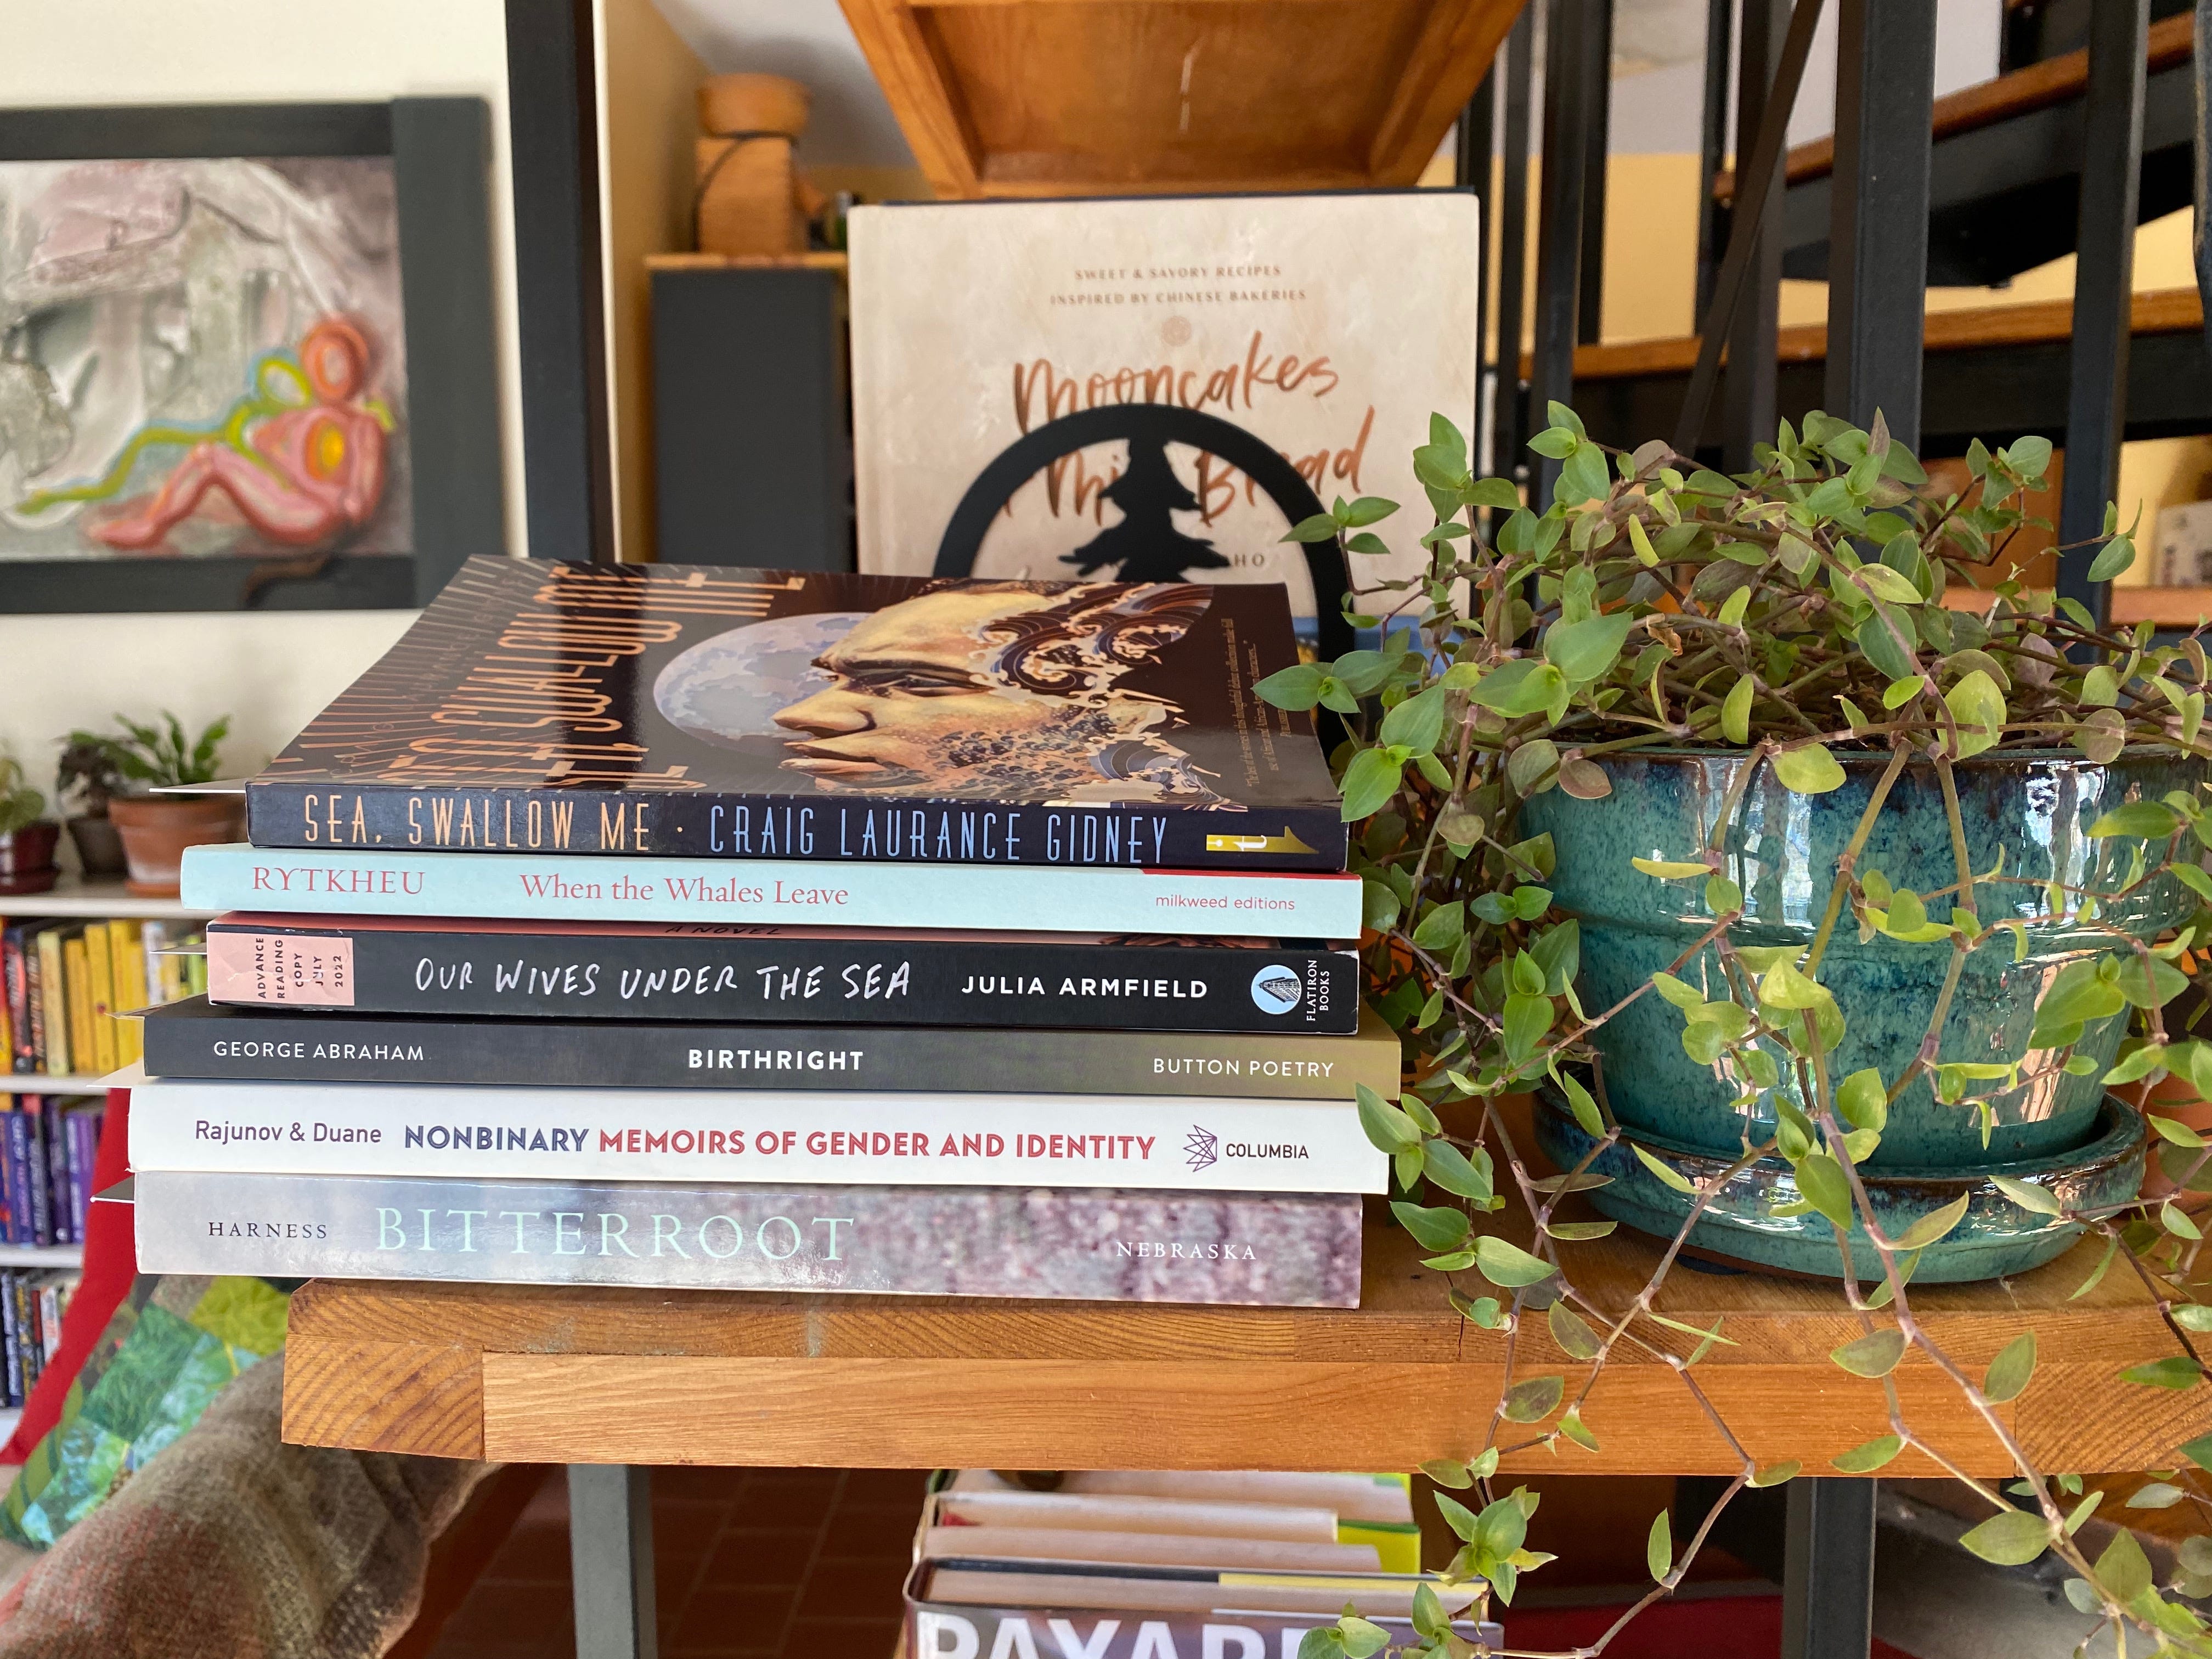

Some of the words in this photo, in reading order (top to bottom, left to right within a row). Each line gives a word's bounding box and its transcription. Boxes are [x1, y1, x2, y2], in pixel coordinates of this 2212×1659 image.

[1075, 269, 1126, 281] SWEET
[1132, 268, 1143, 279] &
[1149, 267, 1208, 279] SAVORY
[1216, 265, 1282, 277] RECIPES
[1050, 294, 1125, 306] INSPIRED
[1131, 292, 1148, 304] BY
[1156, 291, 1222, 303] CHINESE
[1229, 289, 1306, 302] BAKERIES
[1014, 330, 1339, 438] Mooncakes
[532, 565, 806, 617] ME
[431, 617, 684, 731] SWALLOW
[372, 736, 710, 789] SEA,
[304, 794, 382, 843] SEA,
[408, 797, 574, 849] SWALLOW
[601, 802, 649, 851] ME
[711, 805, 814, 855] CRAIG
[840, 808, 1020, 861] LAURANCE
[1047, 812, 1167, 864] GIDNEY
[252, 867, 426, 894] RYTKHEU
[520, 873, 603, 900] When
[611, 874, 654, 901] the
[664, 876, 763, 903] Whales
[774, 879, 849, 905] Leave
[1156, 894, 1228, 909] milkweed
[1234, 896, 1295, 910] editions
[691, 927, 781, 935] NOVEL
[256, 938, 266, 999] ADVANCE
[275, 939, 285, 998] READING
[294, 953, 304, 988] COPY
[313, 956, 324, 986] JULY
[333, 956, 343, 988] 2022
[415, 957, 473, 991] OUR
[495, 959, 601, 997] WIVES
[620, 964, 738, 1000] UNDER
[756, 964, 825, 1001] THE
[841, 960, 910, 1001] SEA
[961, 975, 1046, 995] JULIA
[1059, 977, 1208, 998] ARMFIELD
[1306, 960, 1317, 1022] FLATIRON
[1319, 970, 1330, 1011] BOOKS
[213, 1041, 304, 1058] GEORGE
[313, 1043, 424, 1061] ABRAHAM
[689, 1049, 864, 1070] BIRTHRIGHT
[1154, 1058, 1240, 1075] BUTTON
[1250, 1060, 1334, 1079] POETRY
[195, 1120, 283, 1145] Rajunov
[290, 1123, 306, 1142] &
[314, 1122, 382, 1143] Duane
[405, 1125, 590, 1152] NONBINARY
[600, 1128, 746, 1154] MEMOIRS
[755, 1131, 797, 1155] OF
[806, 1132, 930, 1156] GENDER
[939, 1133, 1005, 1158] AND
[1017, 1133, 1156, 1160] IDENTITY
[1226, 1143, 1309, 1159] COLUMBIA
[208, 1221, 328, 1240] HARNESS
[376, 1207, 854, 1261] BITTERROOT
[1116, 1241, 1257, 1261] NEBRASKA
